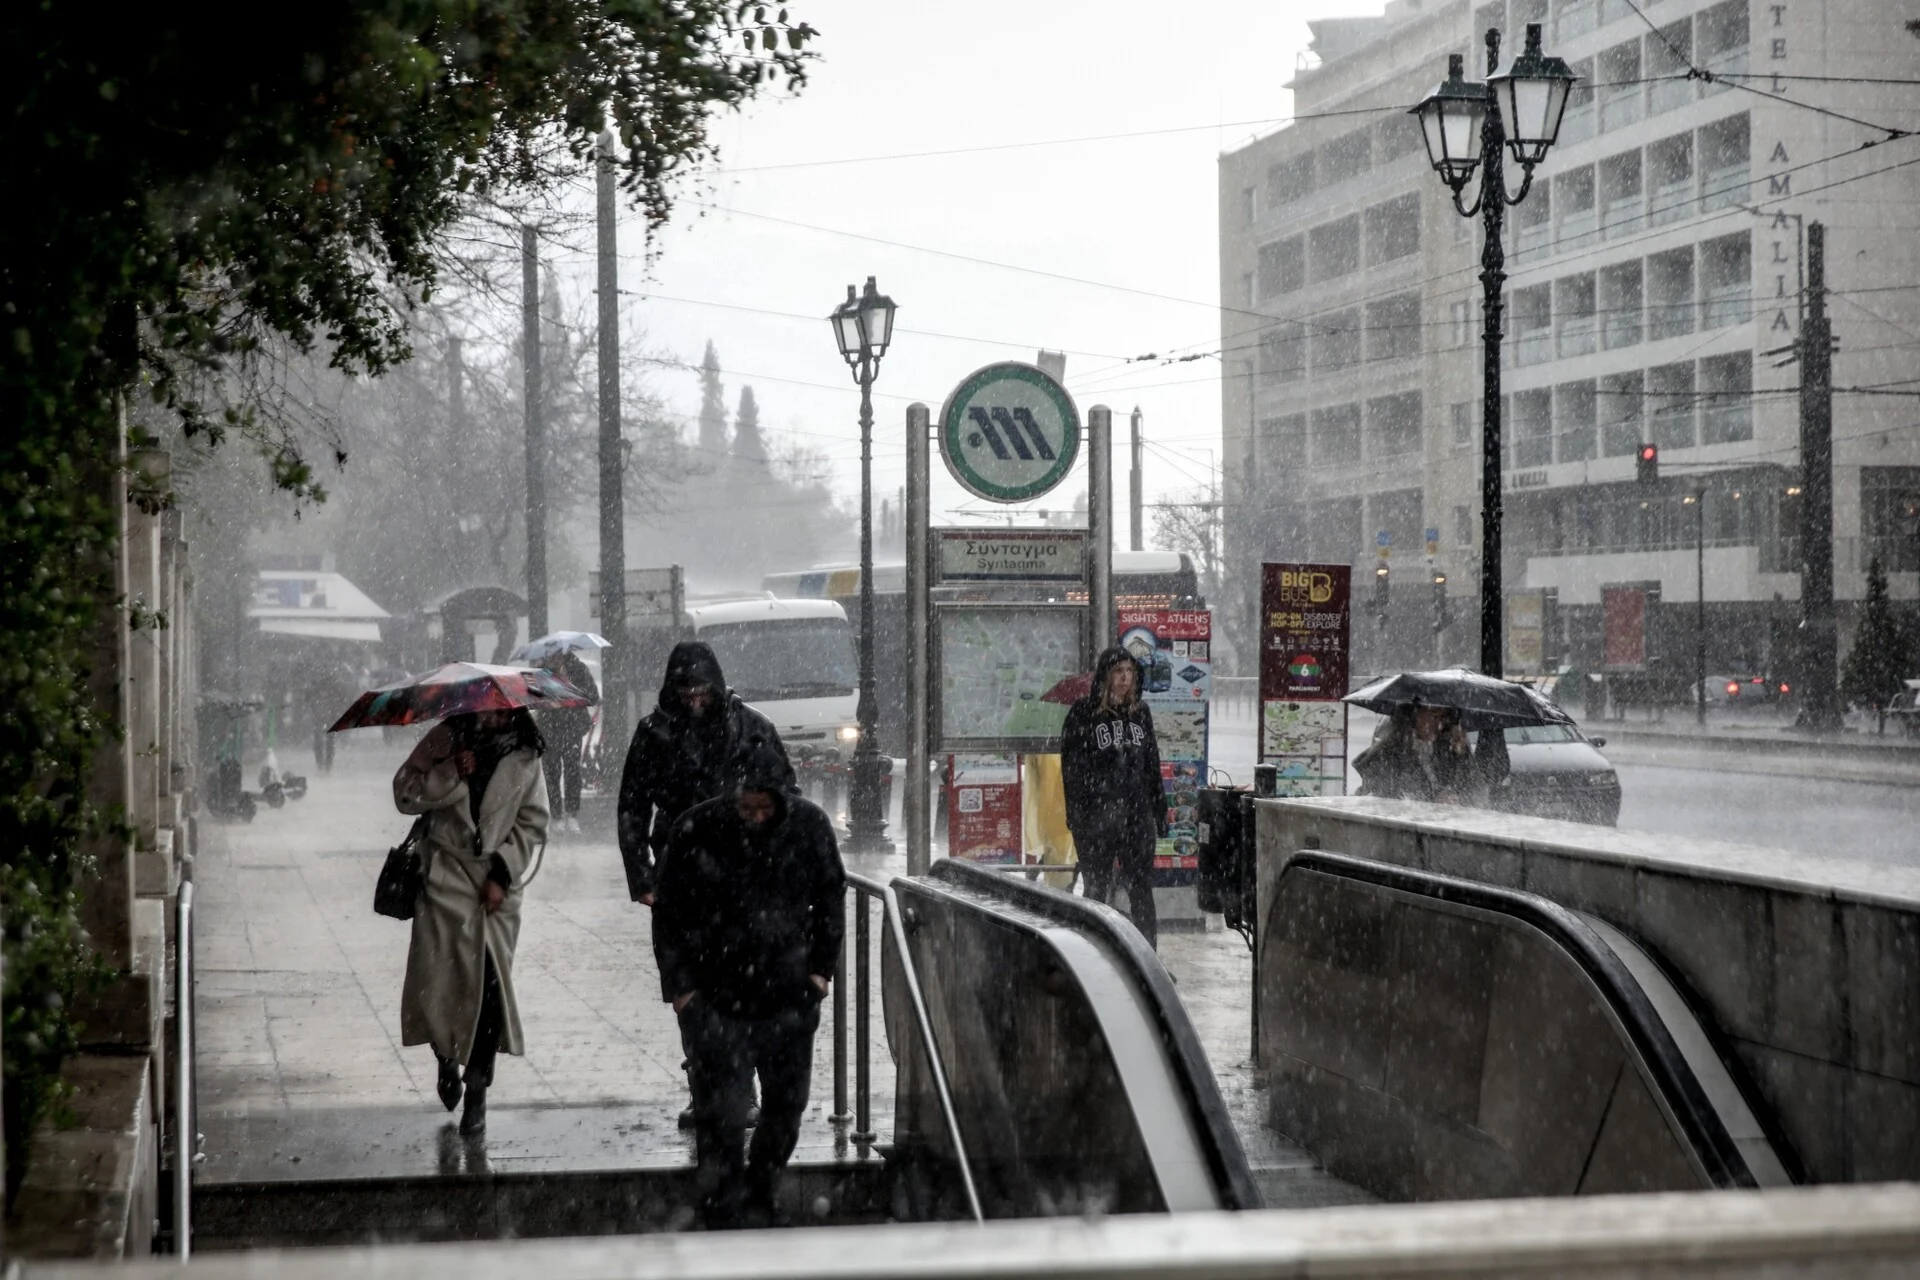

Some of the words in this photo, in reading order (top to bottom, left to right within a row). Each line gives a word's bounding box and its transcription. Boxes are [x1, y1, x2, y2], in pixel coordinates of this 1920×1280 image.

[1769, 140, 1791, 331] AMALIA
[966, 541, 1058, 559] Σύνταγμα
[977, 558, 1046, 571] Syntagma
[1281, 571, 1310, 587] BIG
[1281, 587, 1309, 602] BUS
[1122, 613, 1158, 624] SIGHTS
[1167, 613, 1208, 624] ATHENS
[1271, 612, 1302, 620] HOP-ON
[1304, 612, 1341, 621] DISCOVER
[1271, 620, 1306, 629] HOP-OFF
[1306, 620, 1341, 629] EXPLORE
[1300, 664, 1310, 677] 6
[1095, 719, 1145, 749] GAP
